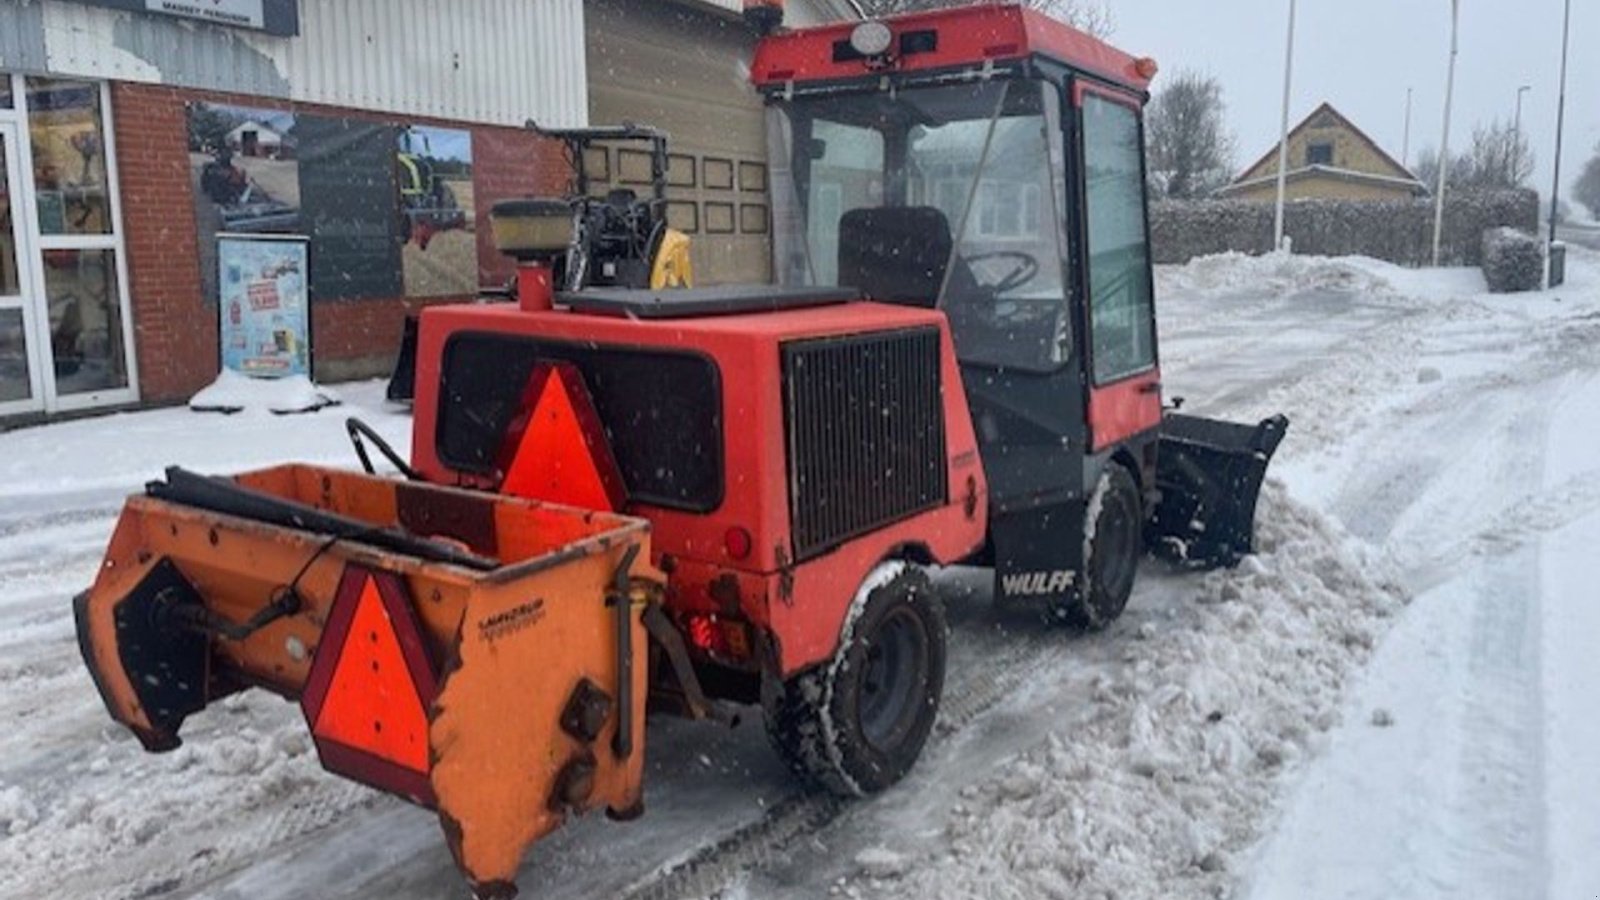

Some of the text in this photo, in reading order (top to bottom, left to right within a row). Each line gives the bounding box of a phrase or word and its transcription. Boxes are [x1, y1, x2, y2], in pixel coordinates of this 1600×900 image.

[162, 1, 251, 22] MASSEY FERGUSON
[1002, 570, 1076, 596] WULFF
